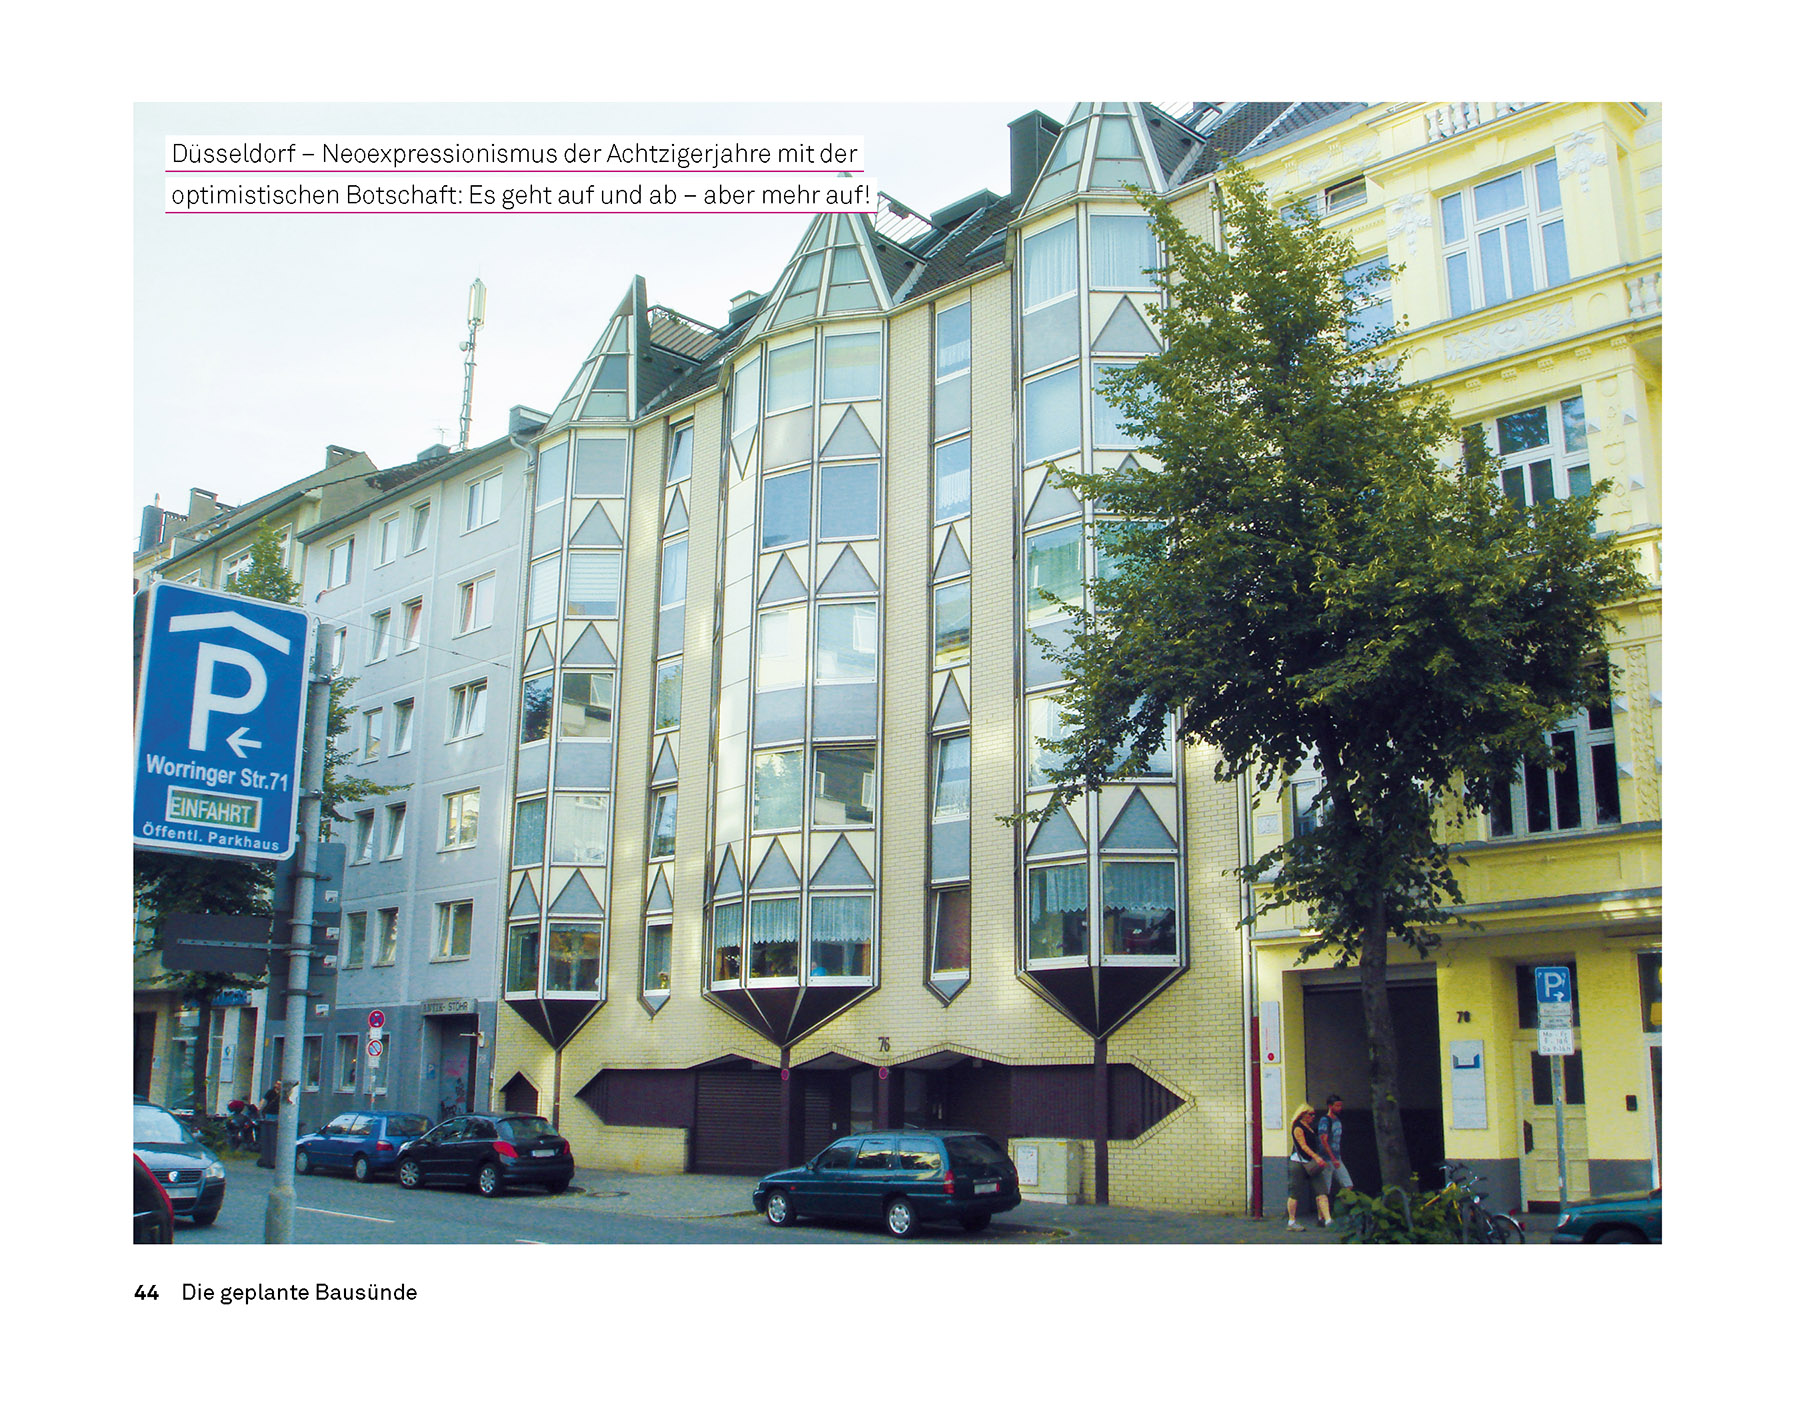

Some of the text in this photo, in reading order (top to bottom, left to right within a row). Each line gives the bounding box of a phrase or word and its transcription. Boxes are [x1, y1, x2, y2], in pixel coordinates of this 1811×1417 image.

[189, 641, 267, 752] P
[146, 752, 236, 788] Worringer
[170, 796, 252, 826] EINFAHRT
[142, 821, 280, 852] Öffentl. Parkhaus
[1544, 972, 1562, 998] P
[877, 1036, 891, 1052] 76
